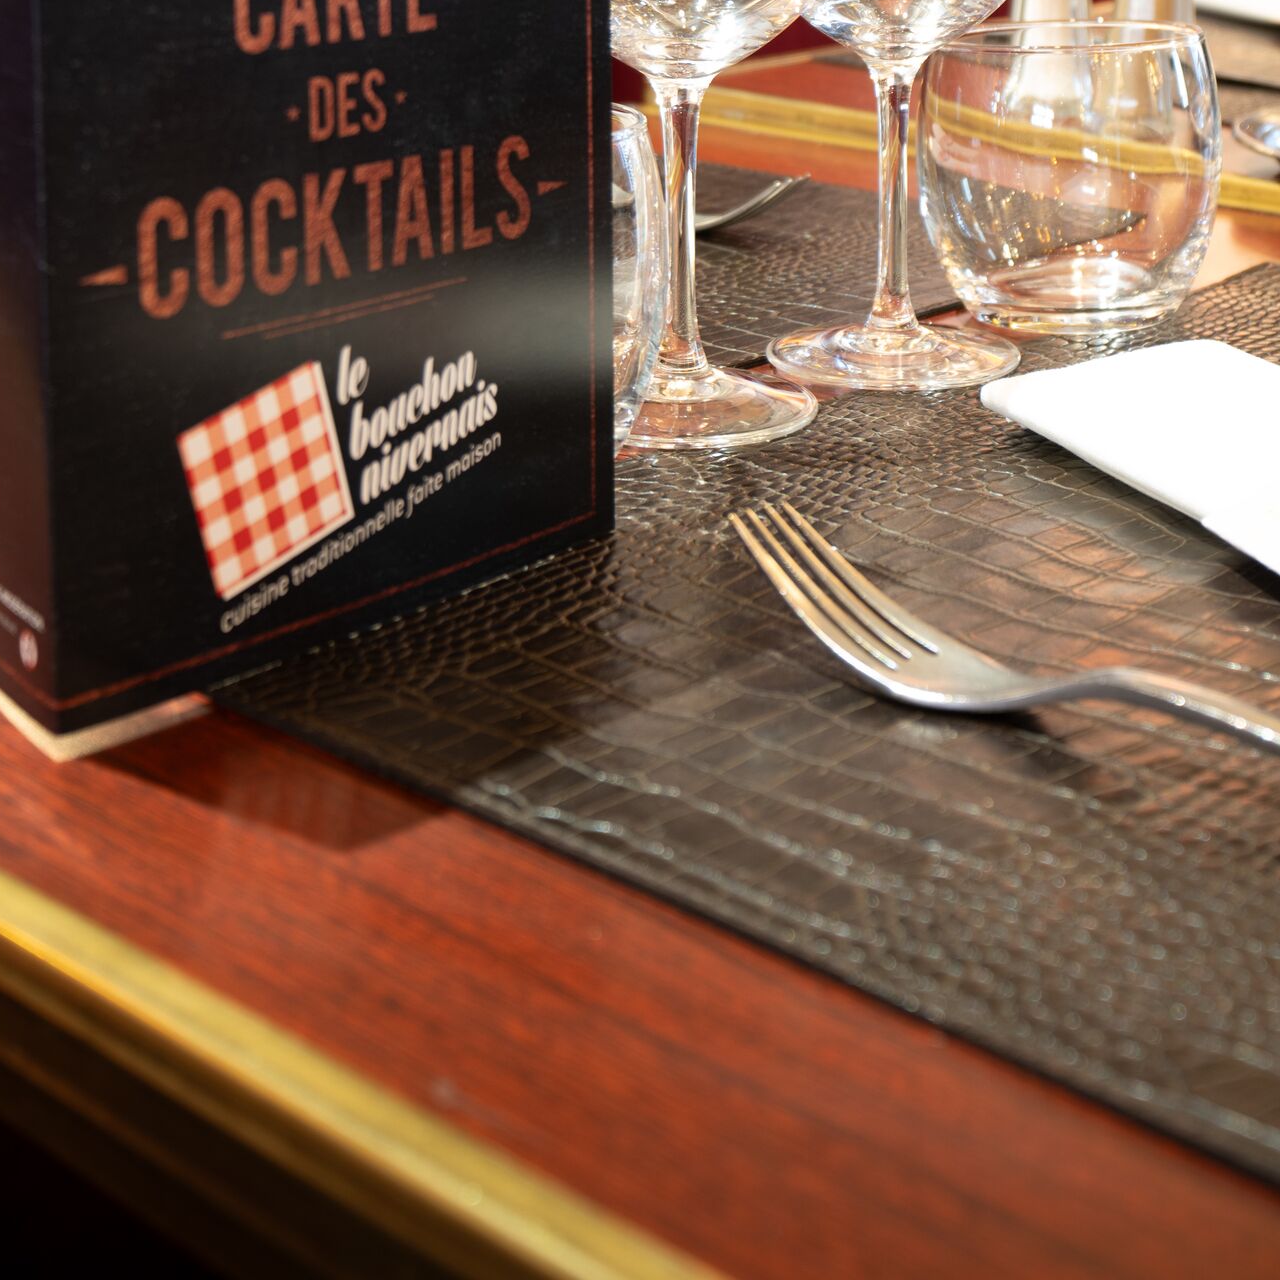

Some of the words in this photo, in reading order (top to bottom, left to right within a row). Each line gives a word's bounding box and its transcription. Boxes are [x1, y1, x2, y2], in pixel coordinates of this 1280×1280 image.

[307, 68, 388, 142] DES
[137, 135, 533, 320] COCKTAILS
[336, 344, 369, 407] le
[349, 350, 478, 462] bouchon
[360, 379, 499, 505] nivernais
[221, 573, 290, 634] cuisine
[290, 499, 406, 588] traditionnelle
[405, 469, 444, 519] faite
[444, 431, 503, 484] maison
